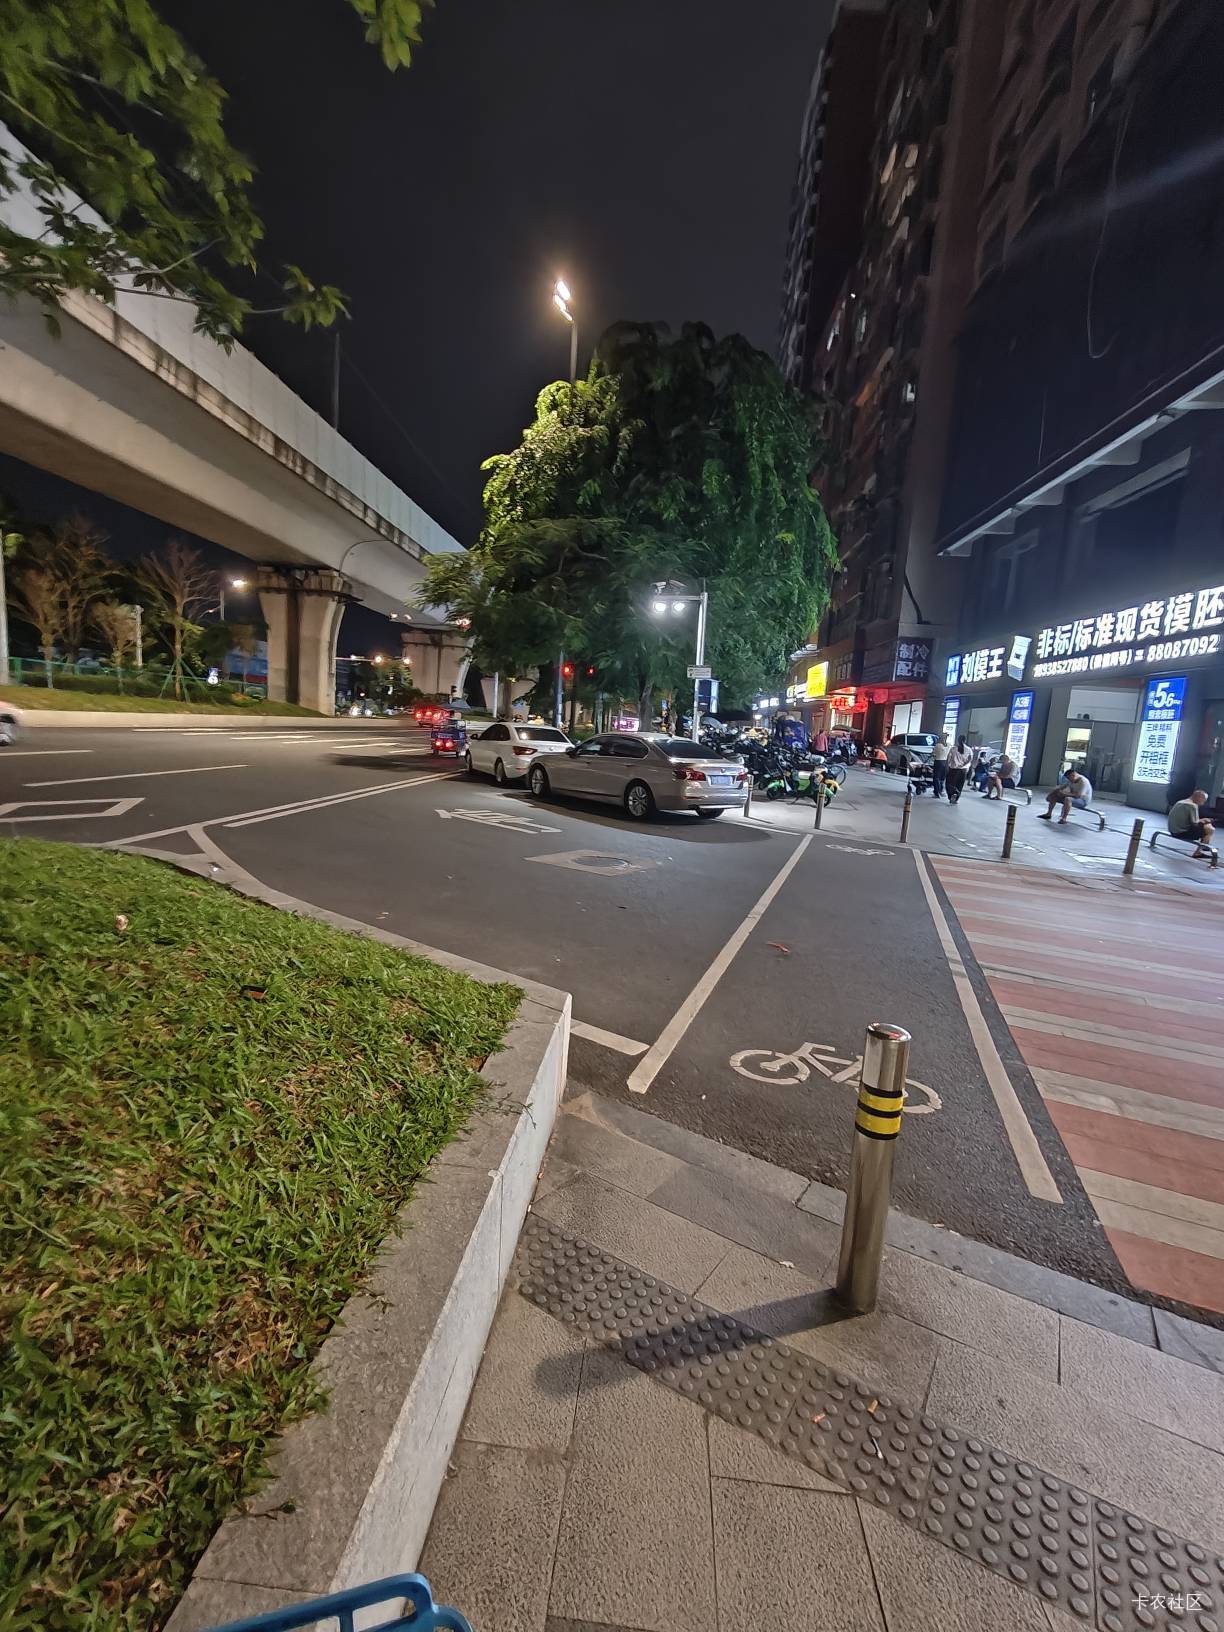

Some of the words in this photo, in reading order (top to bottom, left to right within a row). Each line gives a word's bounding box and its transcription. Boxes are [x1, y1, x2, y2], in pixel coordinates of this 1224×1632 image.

[1146, 634, 1219, 662] 88087092
[960, 647, 1006, 683] 刘模王
